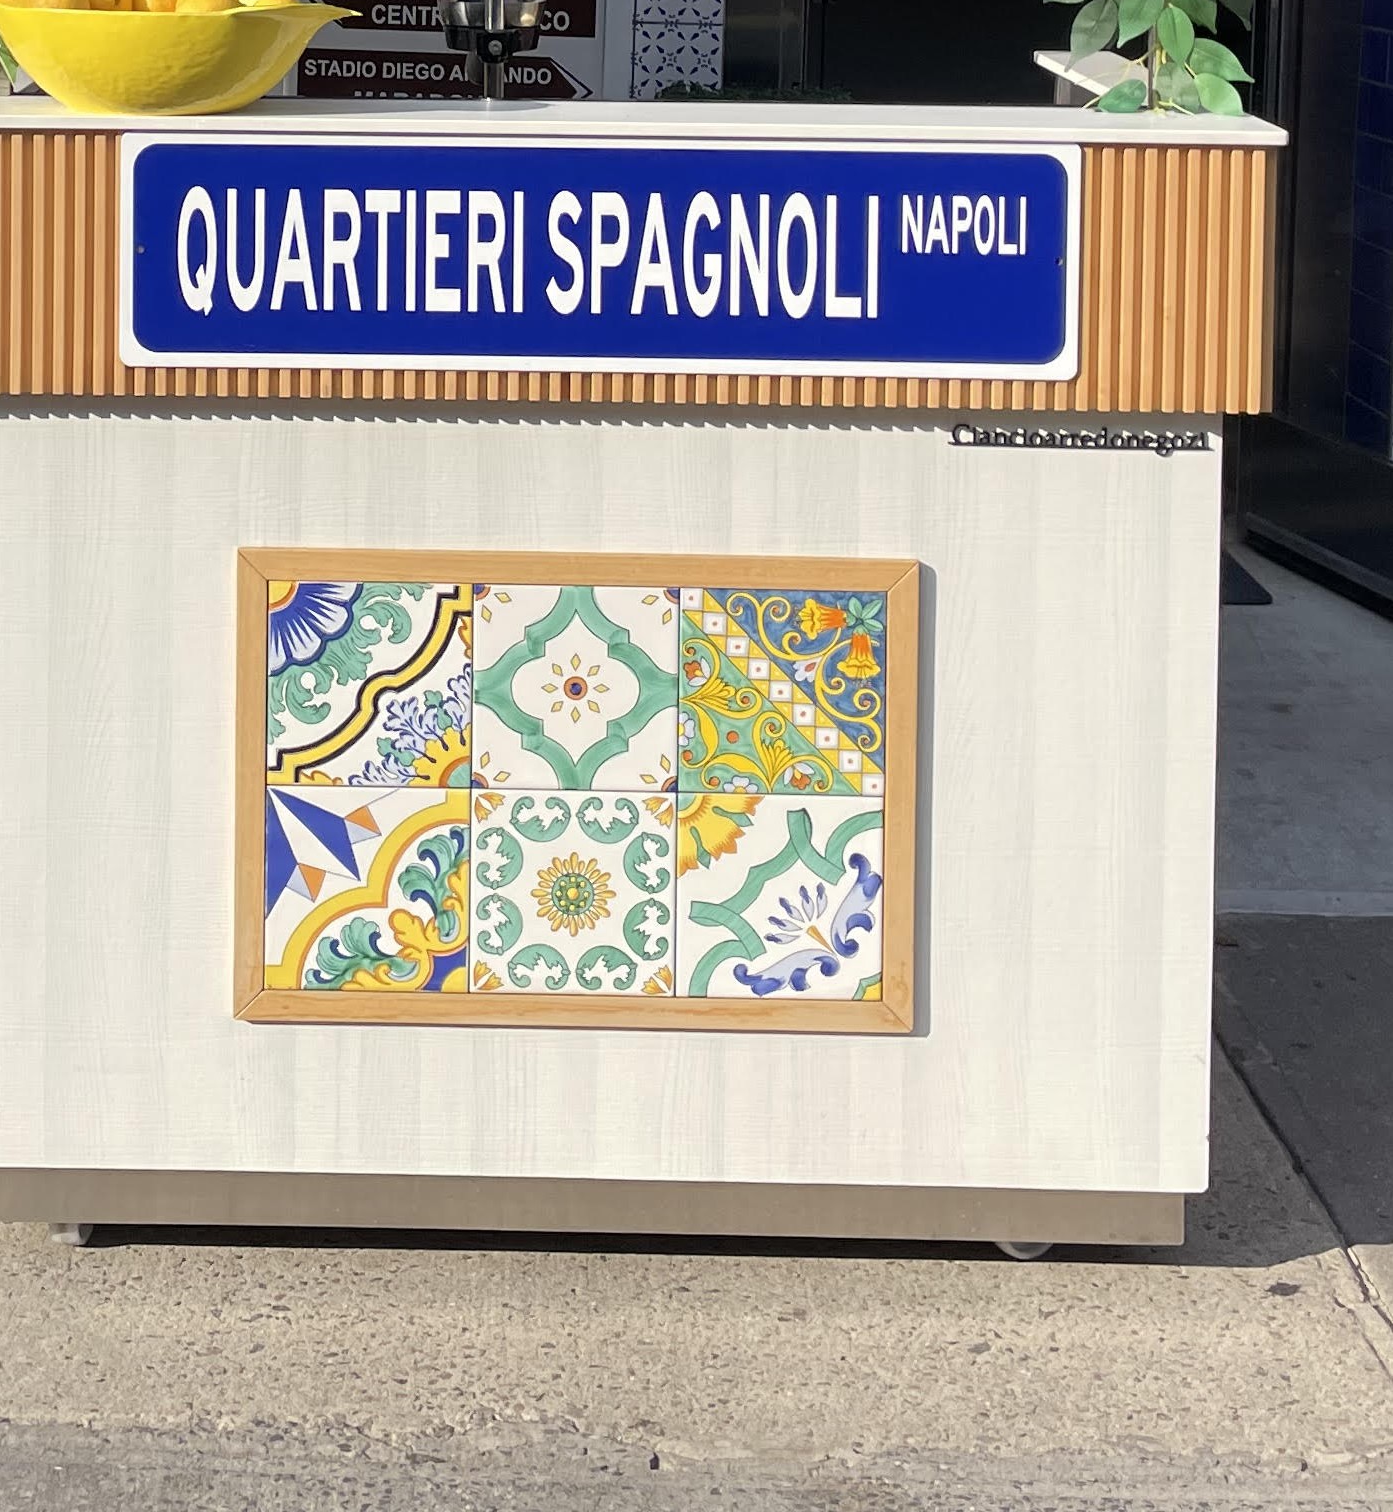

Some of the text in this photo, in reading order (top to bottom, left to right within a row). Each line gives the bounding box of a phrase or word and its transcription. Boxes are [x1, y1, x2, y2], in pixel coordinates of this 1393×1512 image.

[371, 4, 444, 26] CENTR
[305, 59, 377, 79] STADIO
[382, 62, 445, 82] DIEGO
[177, 185, 1027, 319] QUARTIERI SPAGNOLI NAPOLI
